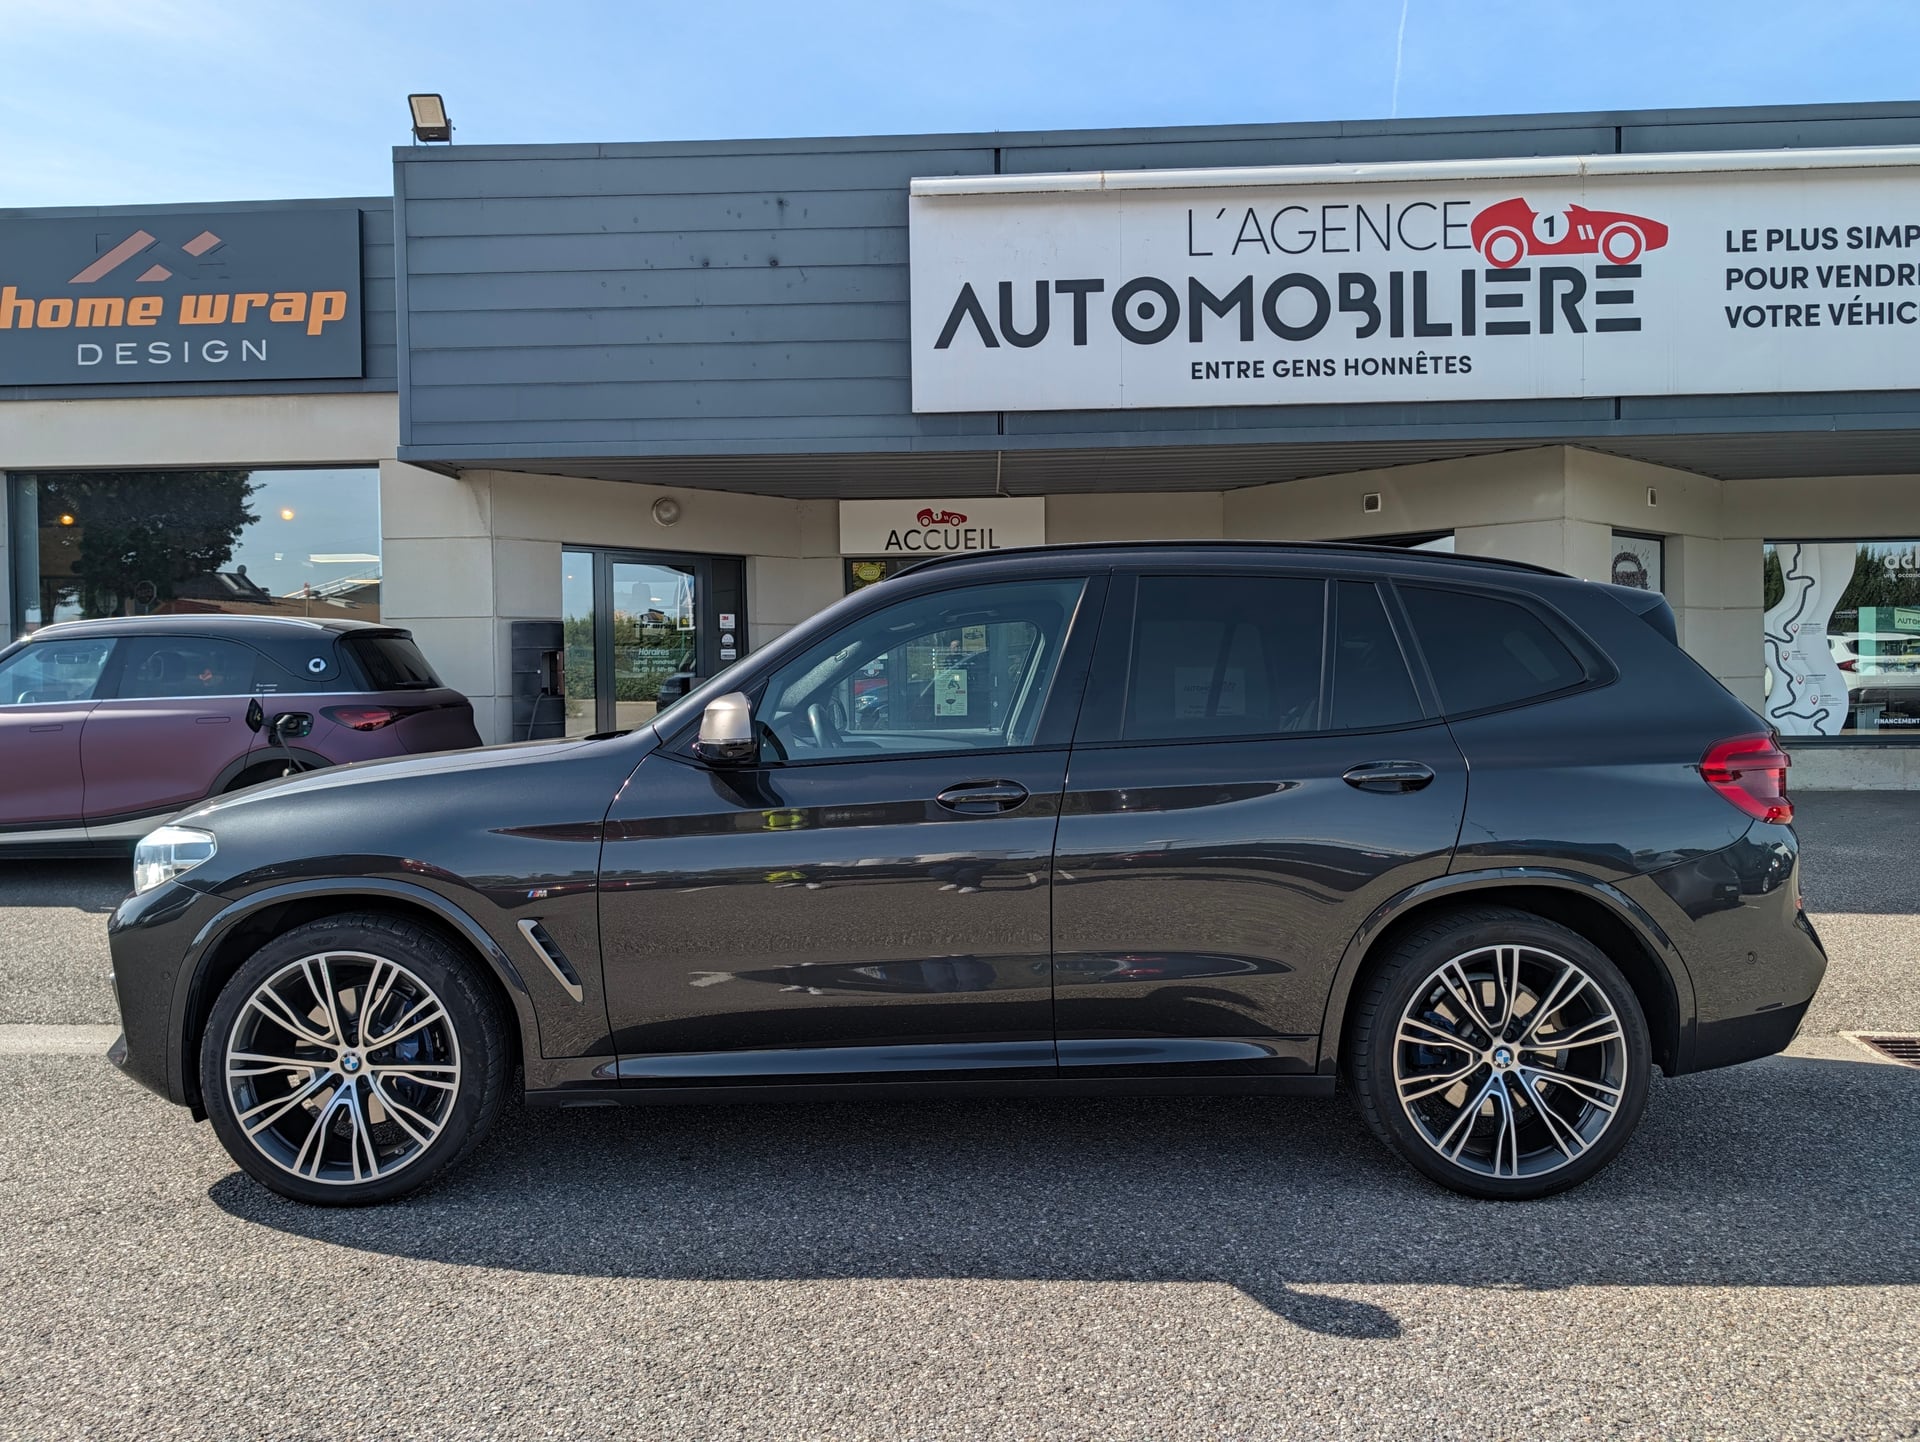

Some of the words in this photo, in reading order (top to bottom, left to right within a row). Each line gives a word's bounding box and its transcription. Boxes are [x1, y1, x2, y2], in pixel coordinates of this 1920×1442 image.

[1543, 216, 1556, 238] 1
[1726, 229, 1758, 253] LE
[1766, 227, 1839, 251] PLUS
[1726, 266, 1809, 291] POUR
[1816, 263, 1920, 289] VENDR
[0, 286, 164, 328] home
[178, 291, 347, 336] wrap
[1724, 304, 1821, 328] VOTRE
[77, 339, 267, 366] DESIGN
[1191, 360, 1265, 380] ENTRE
[1272, 358, 1336, 378] GENS
[1344, 350, 1472, 377] HONNÊTES
[885, 528, 1001, 551] ACCUEIL
[638, 648, 670, 656] Horaires
